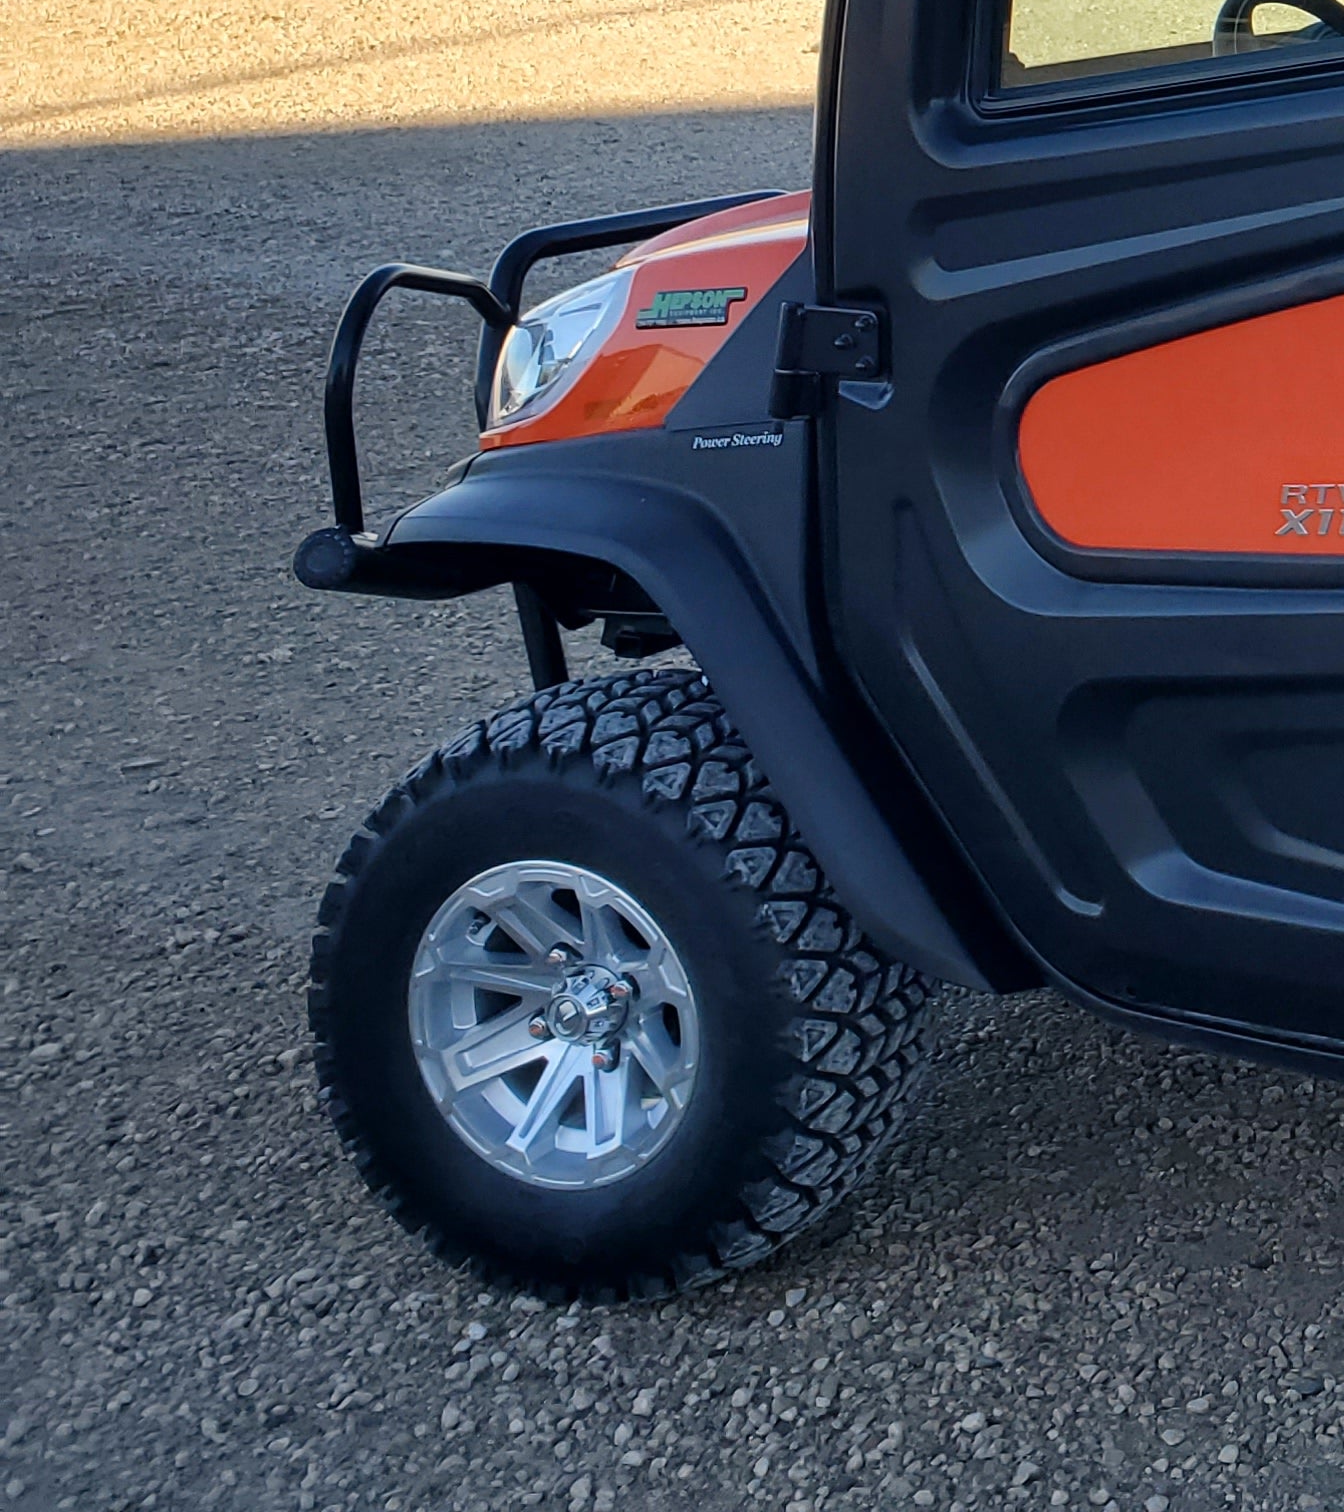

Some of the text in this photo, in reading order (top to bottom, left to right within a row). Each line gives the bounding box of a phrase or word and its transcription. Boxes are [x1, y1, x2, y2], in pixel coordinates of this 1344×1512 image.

[637, 289, 745, 319] HEPSON
[692, 431, 783, 449] Power Steering
